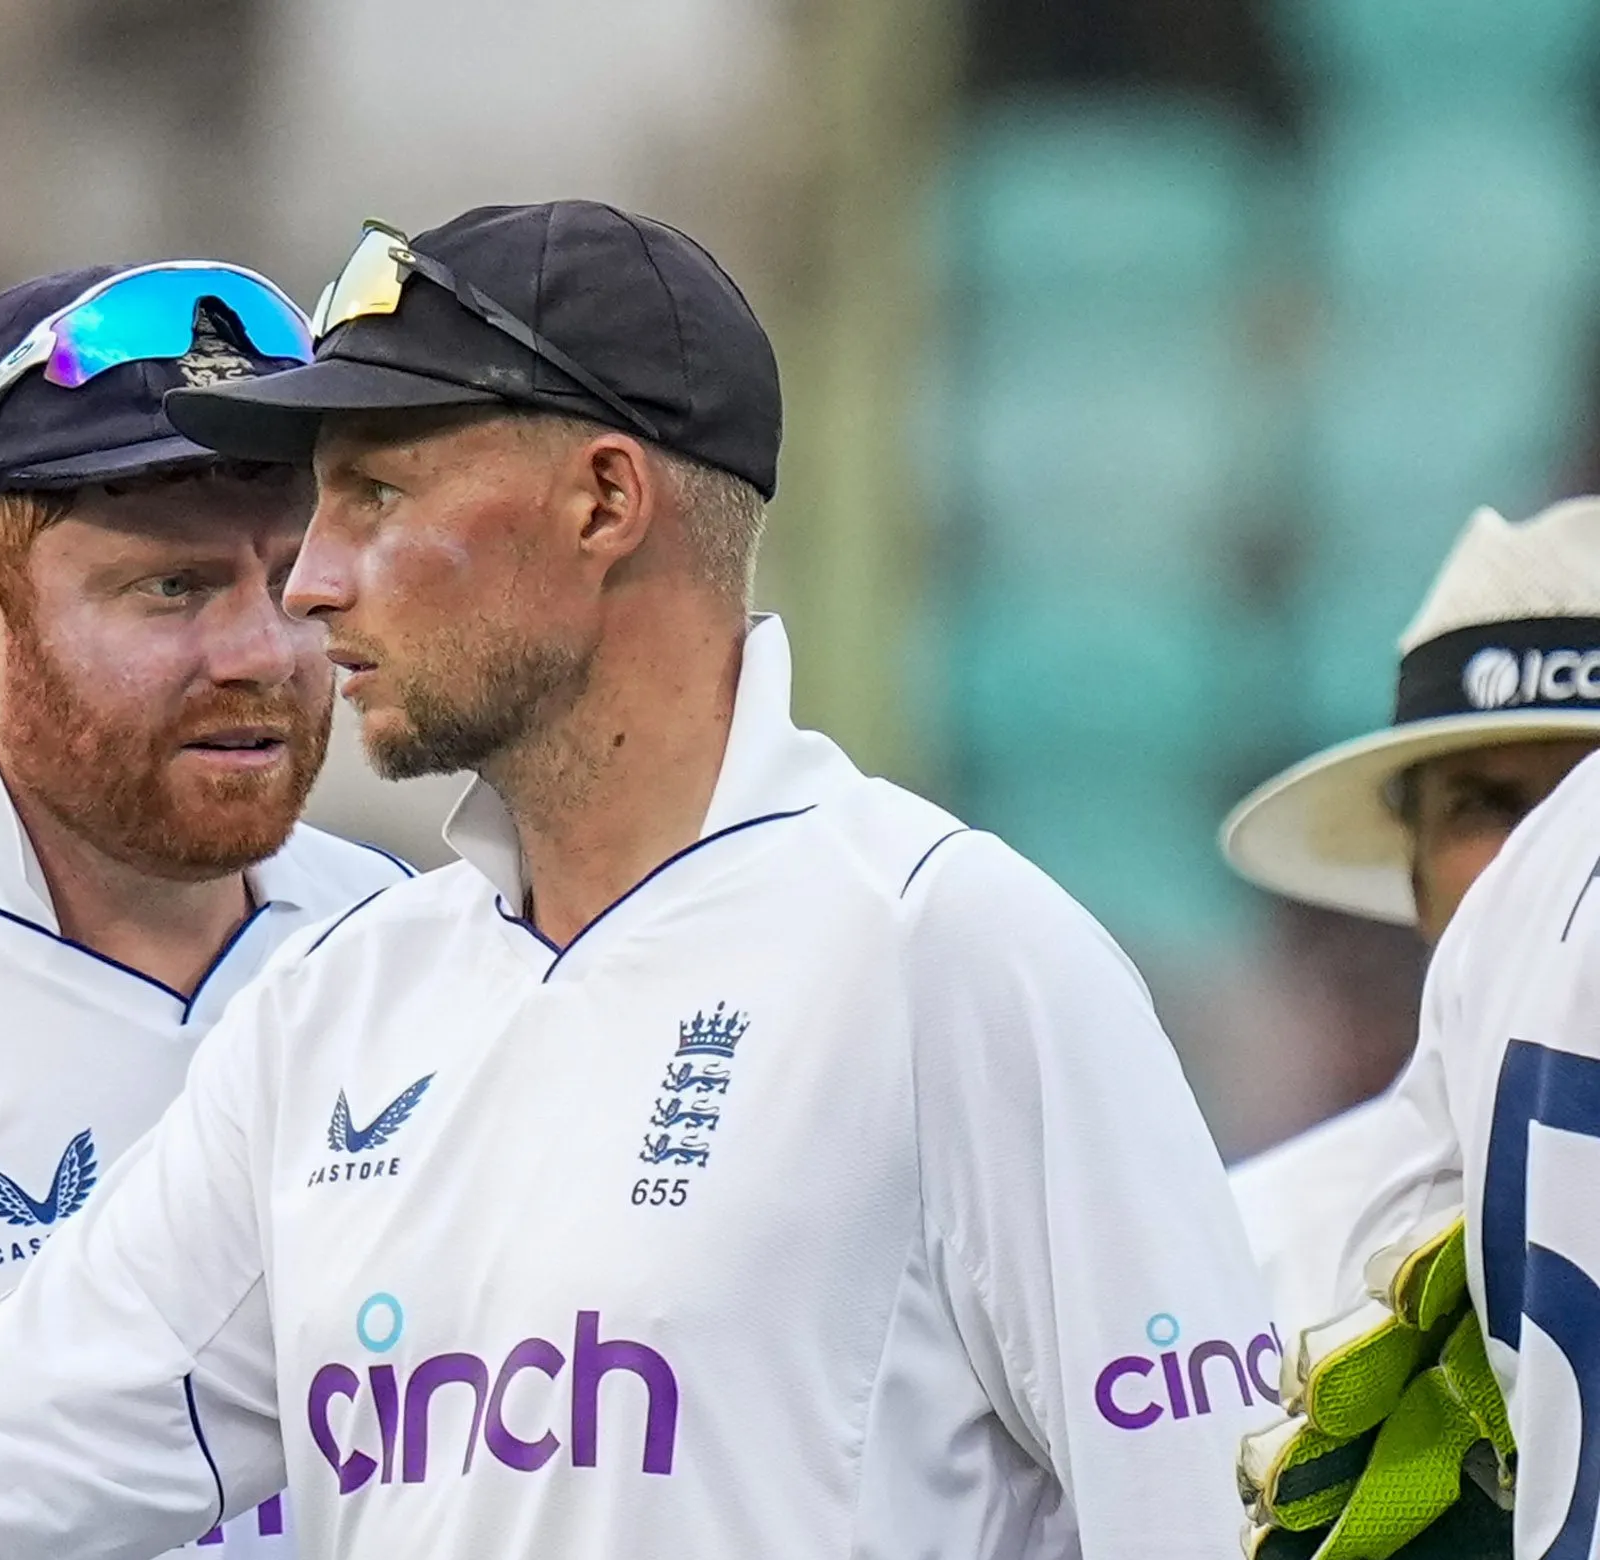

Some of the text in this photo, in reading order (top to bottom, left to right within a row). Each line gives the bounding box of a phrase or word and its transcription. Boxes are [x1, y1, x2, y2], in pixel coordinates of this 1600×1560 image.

[631, 1178, 689, 1207] 655
[308, 1292, 679, 1496] cinch
[1094, 1312, 1284, 1430] cinc
